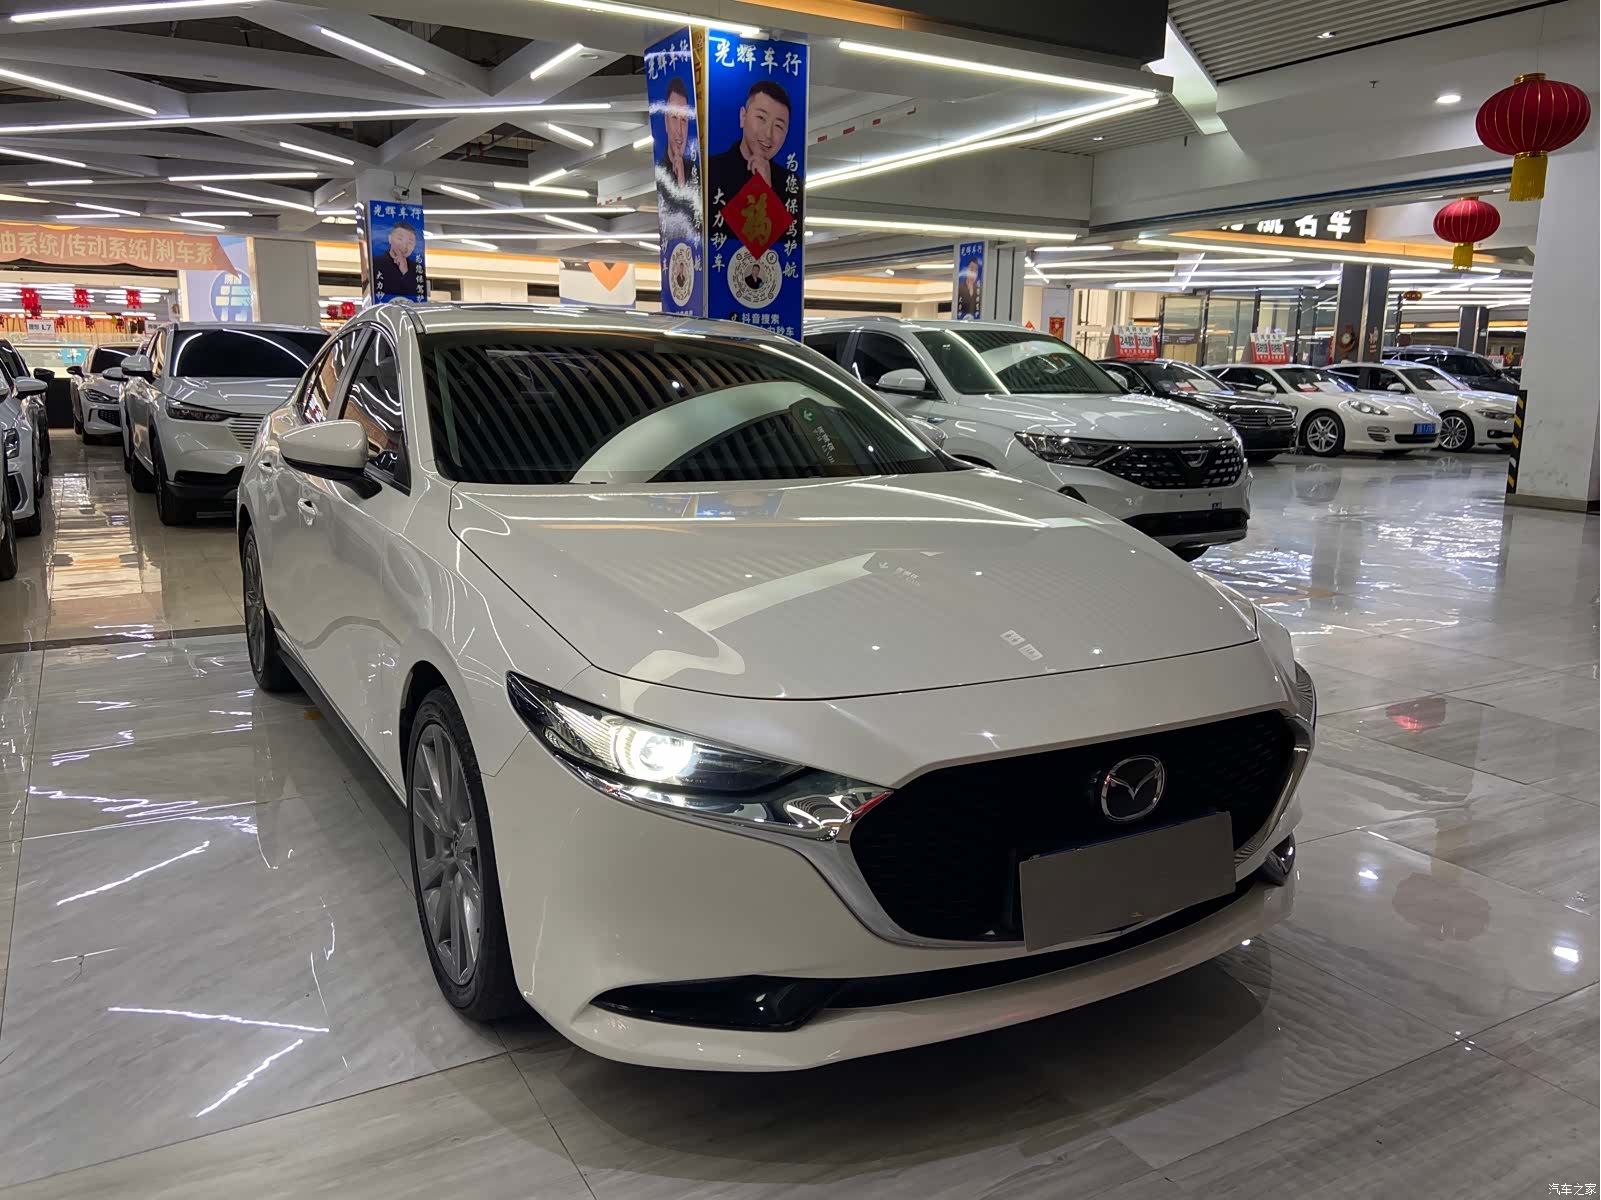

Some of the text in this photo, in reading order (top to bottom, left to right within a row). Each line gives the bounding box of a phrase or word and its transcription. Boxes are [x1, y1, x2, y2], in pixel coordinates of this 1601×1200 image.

[715, 39, 802, 76] 光辉车行
[710, 187, 727, 273] 大力秒车
[741, 193, 772, 245] 福
[742, 312, 780, 324] 抖音搜索
